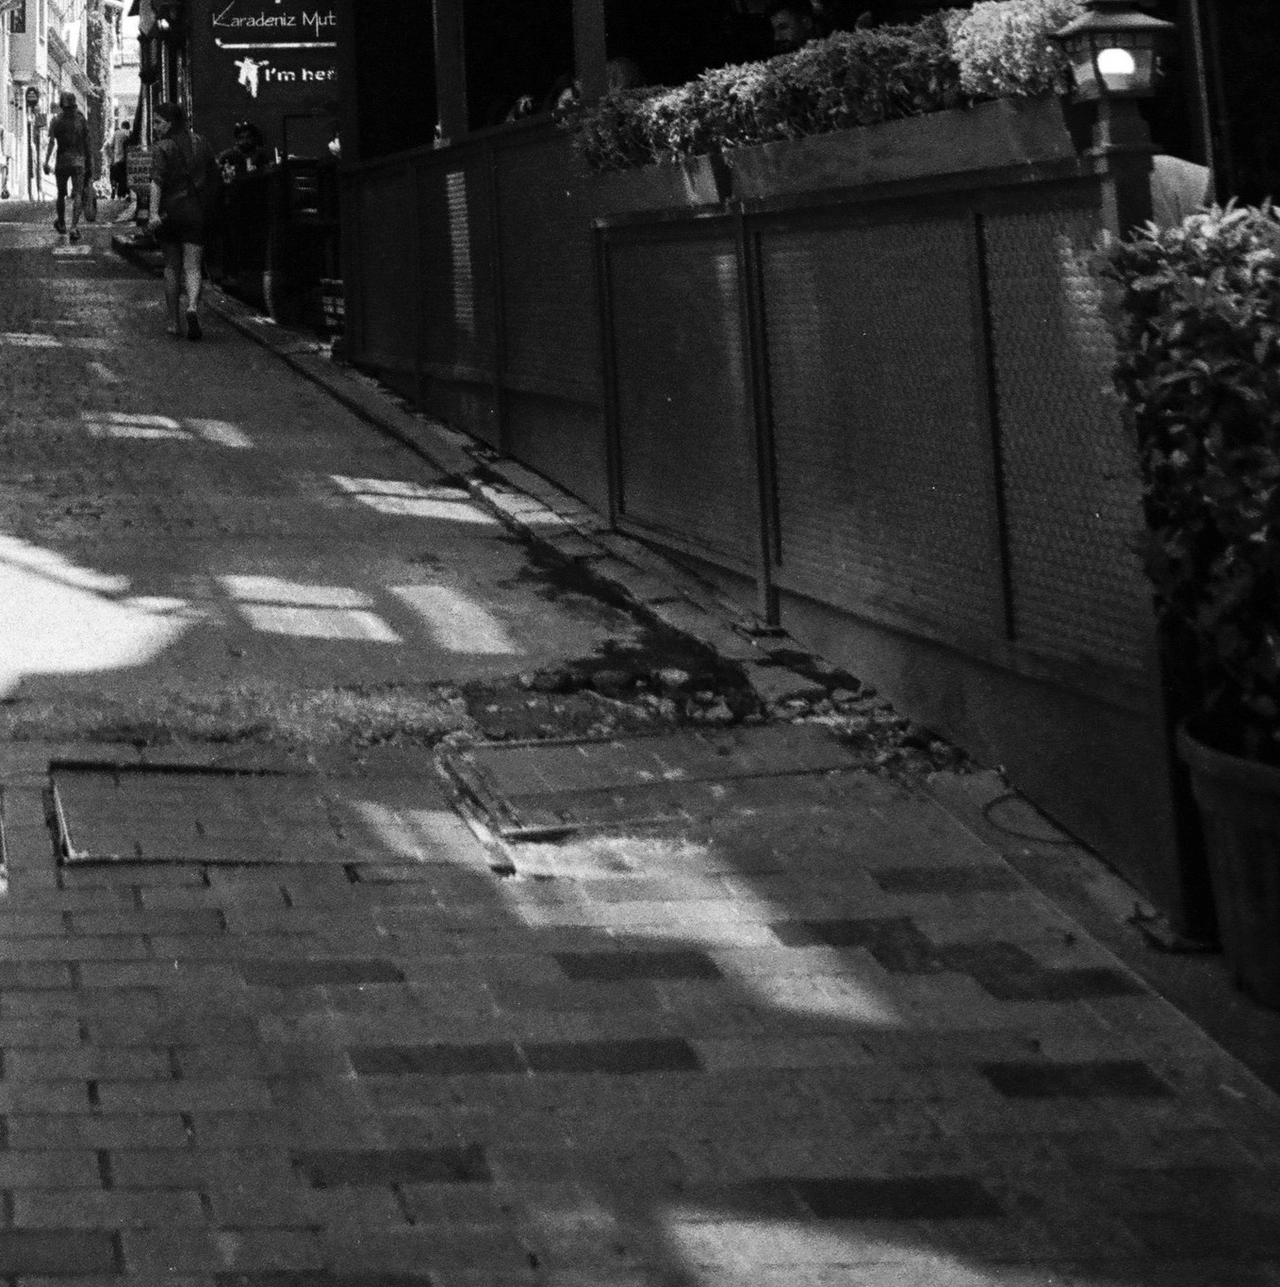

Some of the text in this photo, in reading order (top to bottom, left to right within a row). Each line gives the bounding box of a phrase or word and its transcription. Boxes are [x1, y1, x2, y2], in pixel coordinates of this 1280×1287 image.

[212, 0, 337, 38] Karadeniz Mut
[265, 67, 296, 82] I'm
